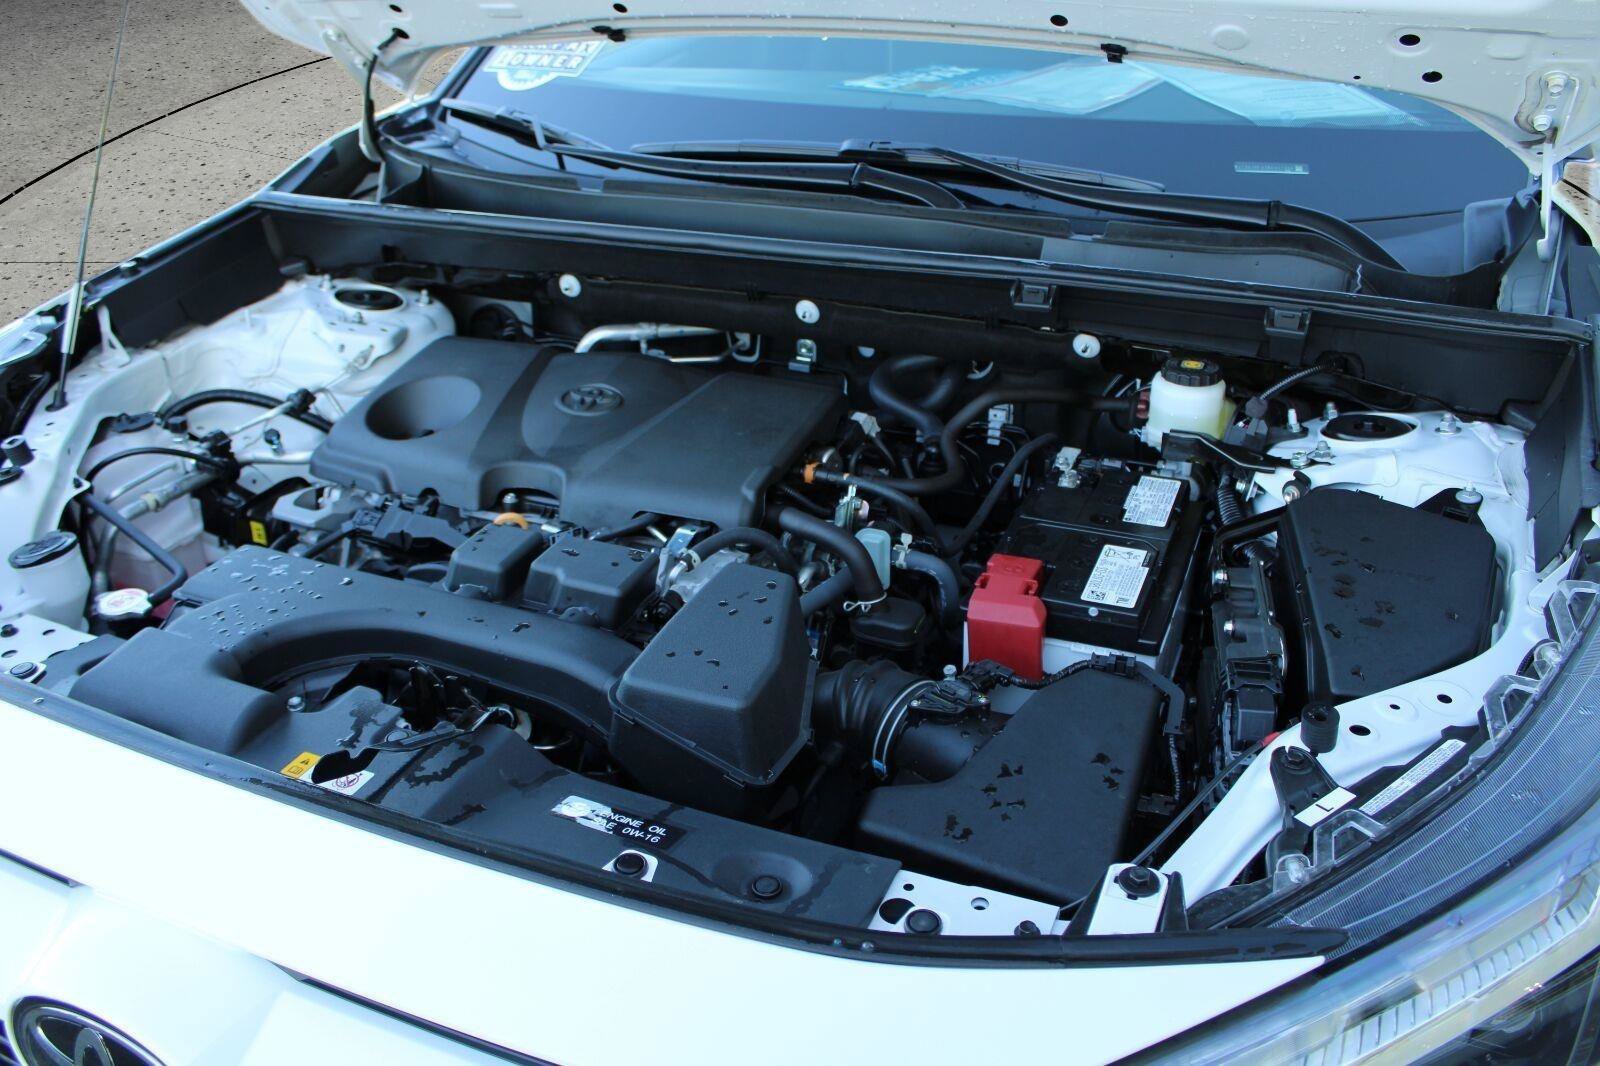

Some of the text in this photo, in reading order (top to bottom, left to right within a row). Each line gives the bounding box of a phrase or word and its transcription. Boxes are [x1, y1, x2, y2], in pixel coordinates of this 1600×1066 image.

[600, 812, 666, 836] ENGINE OIL
[621, 828, 660, 843] 0W-16
